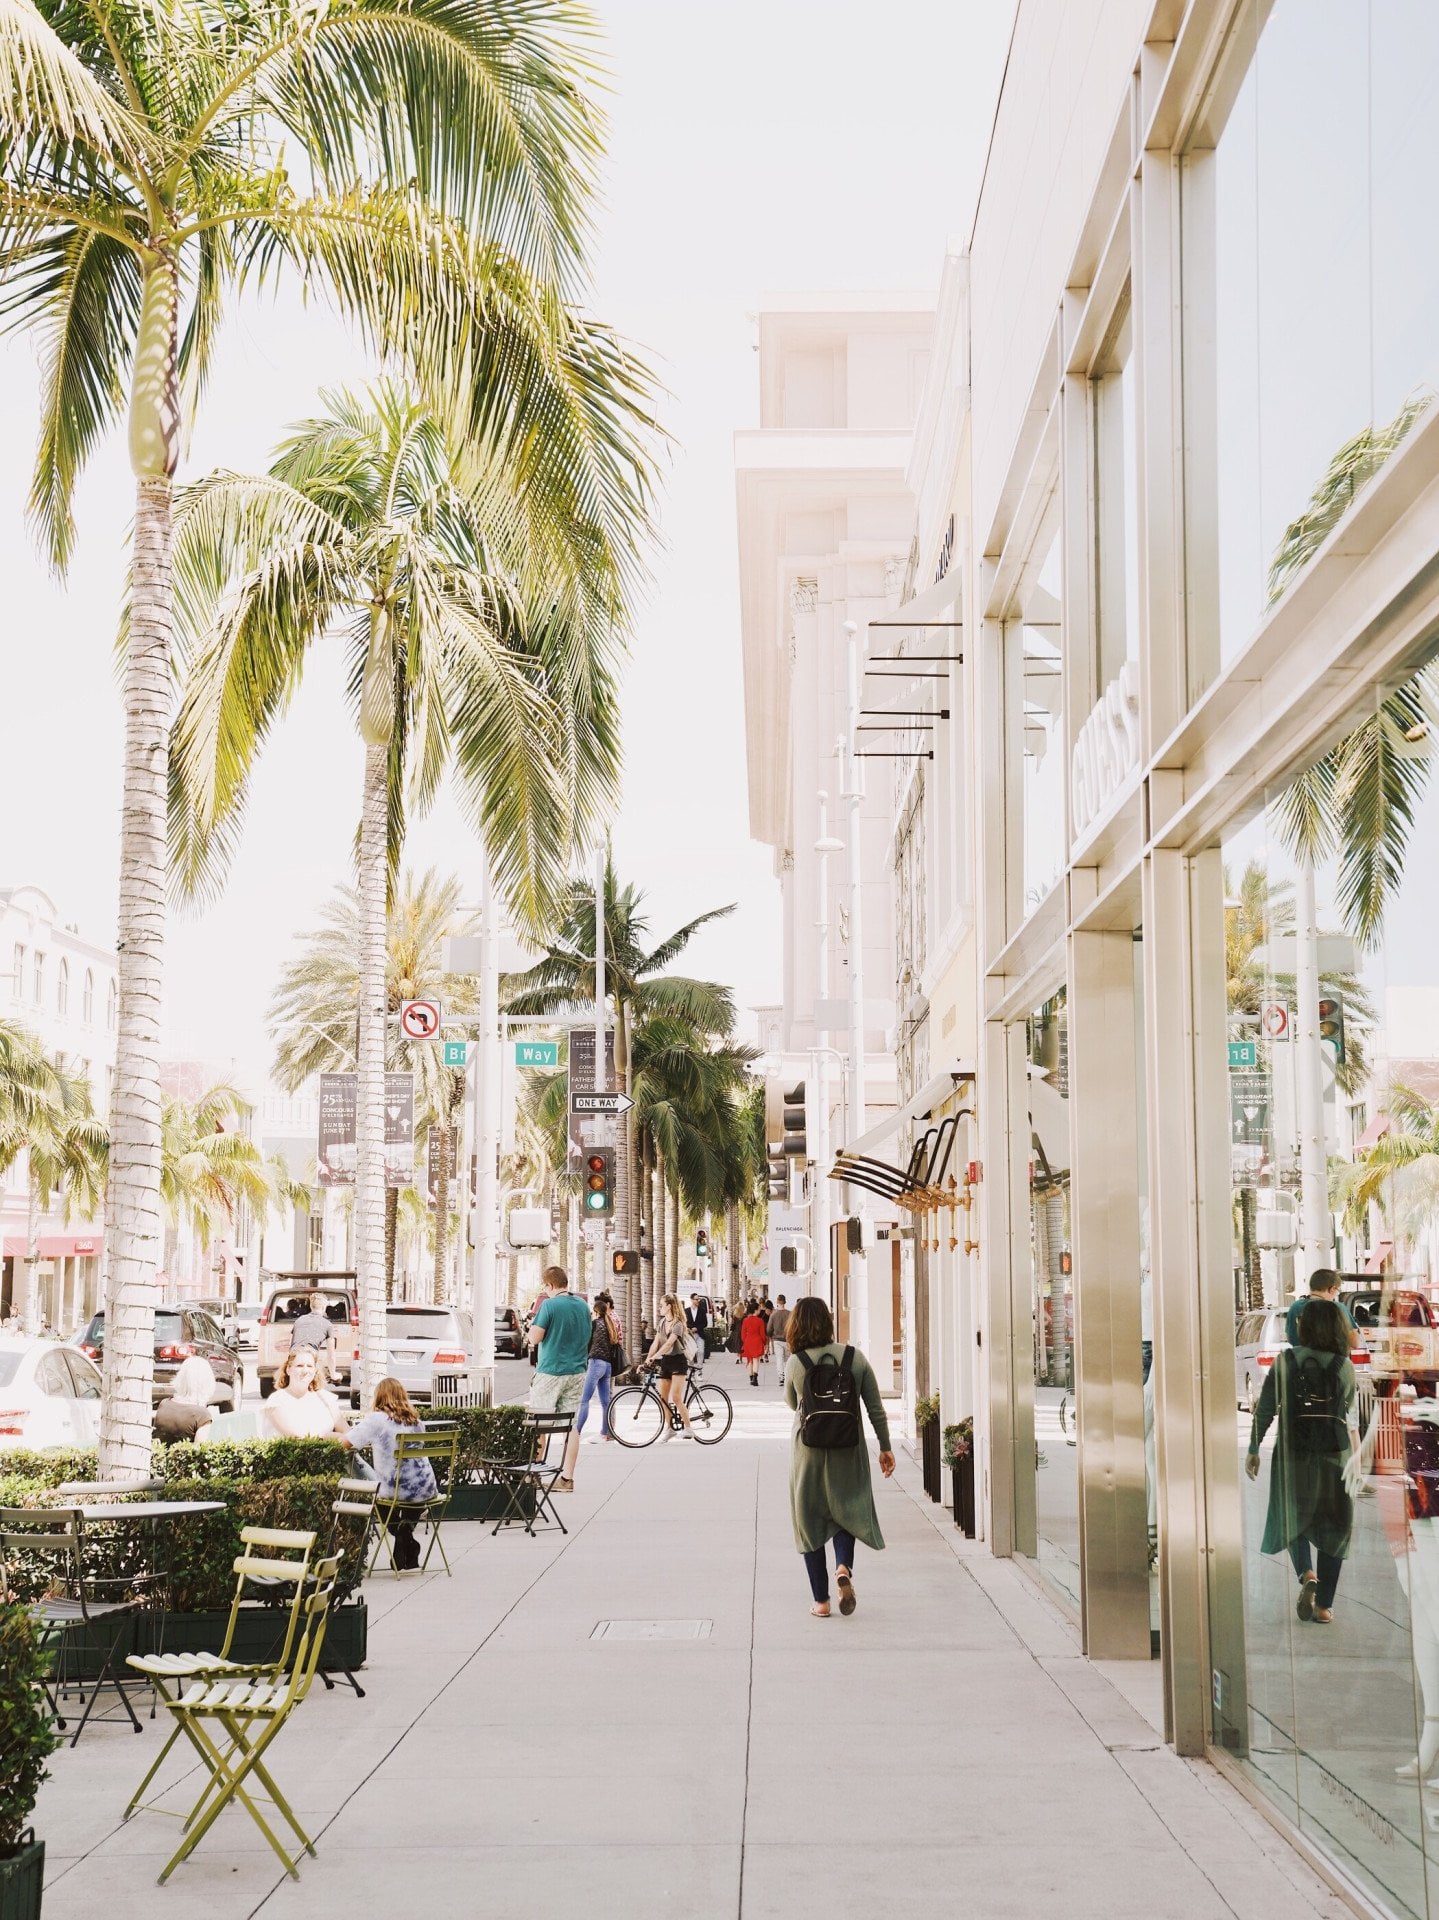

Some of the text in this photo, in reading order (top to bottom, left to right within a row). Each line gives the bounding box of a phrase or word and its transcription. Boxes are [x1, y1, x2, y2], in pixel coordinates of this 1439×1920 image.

[523, 1048, 551, 1063] Way
[578, 1099, 617, 1107] ONE WAY
[79, 1240, 93, 1249] 360
